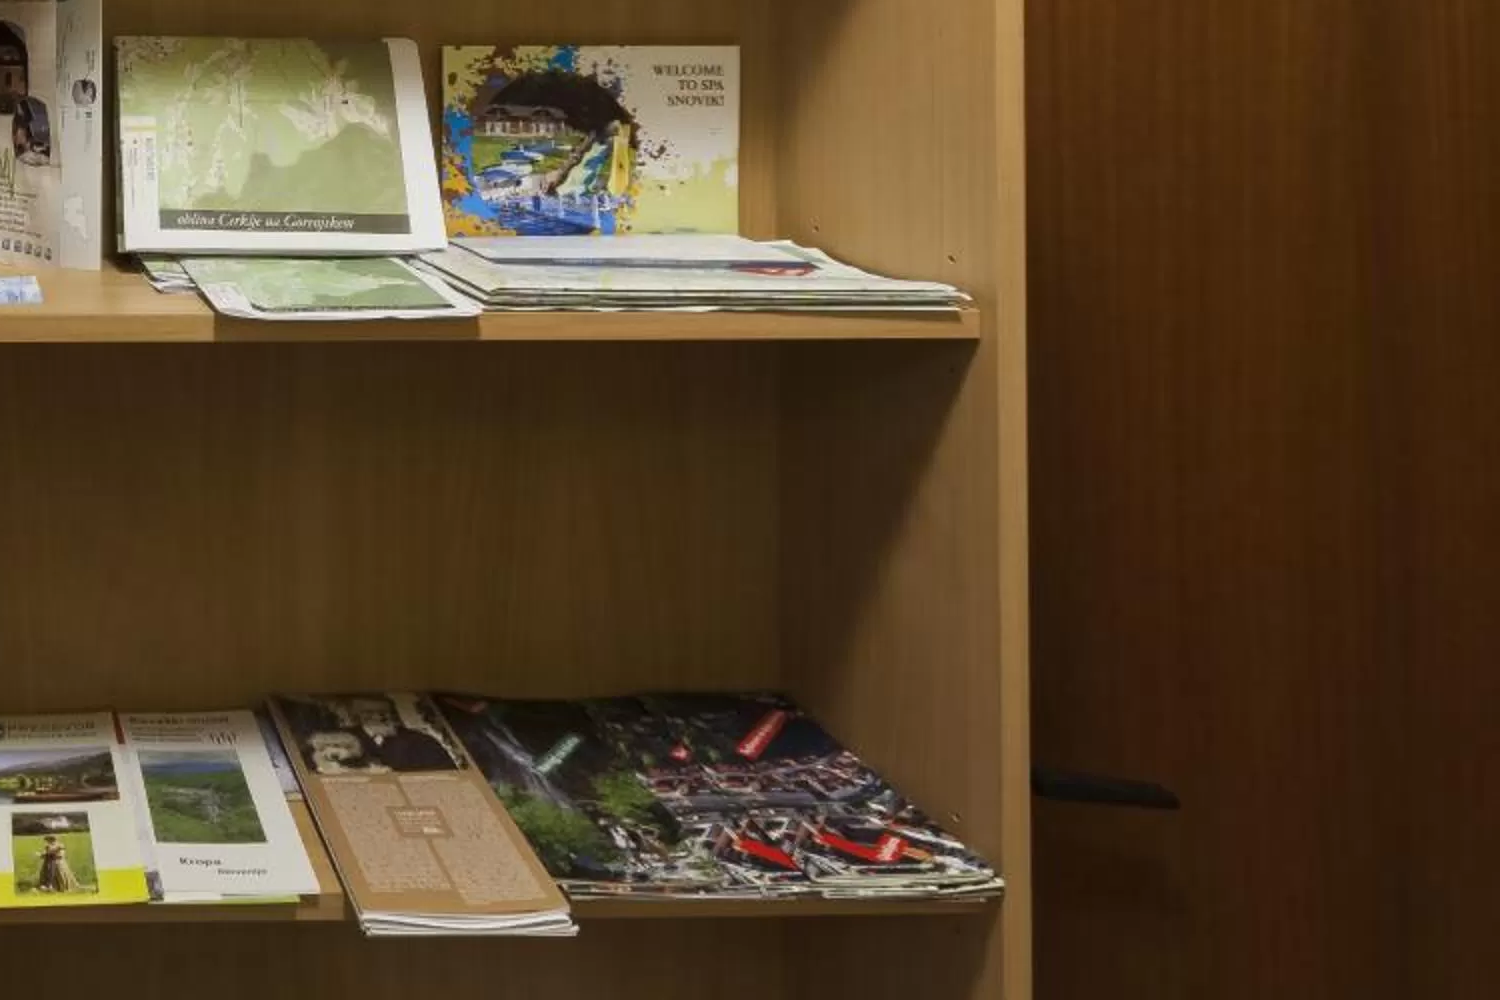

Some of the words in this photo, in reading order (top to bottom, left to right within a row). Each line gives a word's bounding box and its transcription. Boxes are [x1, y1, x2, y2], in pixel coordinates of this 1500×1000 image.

[652, 63, 725, 77] WELCOME
[677, 79, 698, 91] TO
[700, 79, 725, 91] SPA
